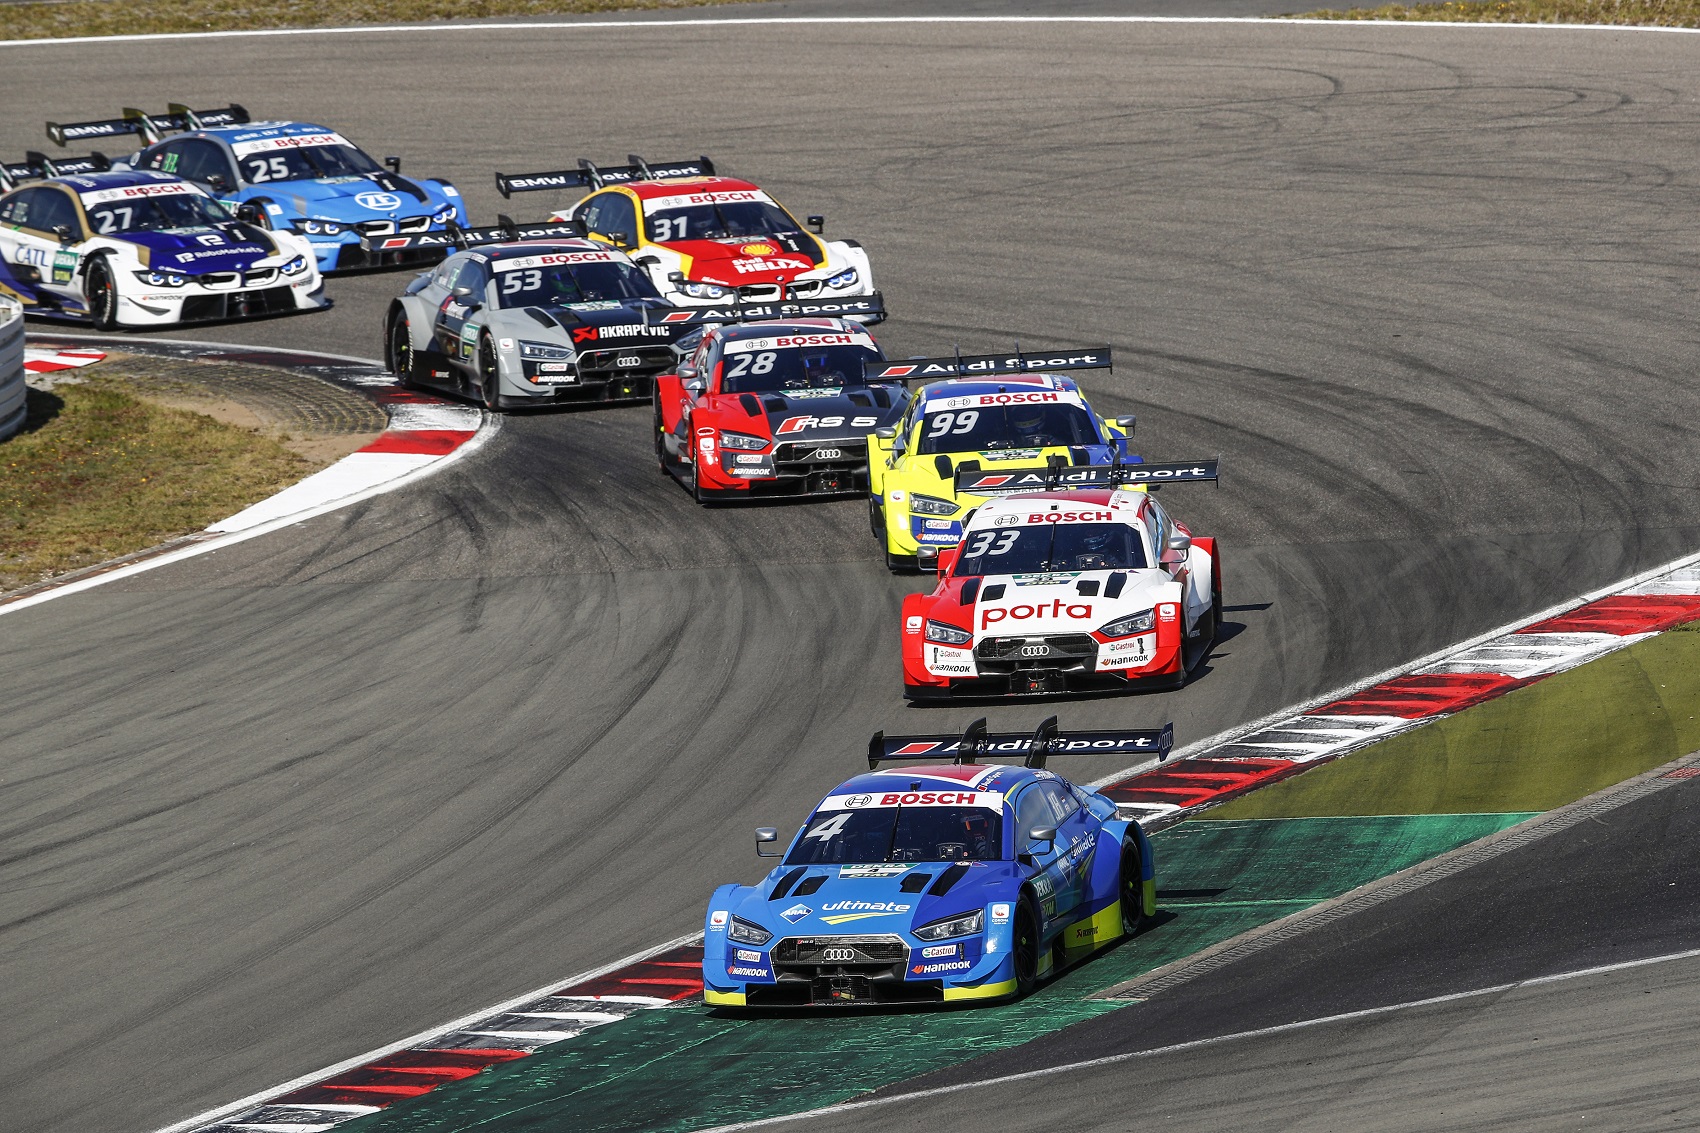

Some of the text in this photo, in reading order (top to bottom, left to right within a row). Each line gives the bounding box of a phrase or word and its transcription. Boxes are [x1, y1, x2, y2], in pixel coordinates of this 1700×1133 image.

[63, 124, 115, 137] BMW
[275, 135, 337, 148] BOSCH
[249, 157, 289, 184] 25
[509, 176, 567, 189] BMW
[124, 184, 186, 197] BOSCH
[690, 192, 755, 204] BOSCH
[95, 207, 133, 235] 27
[654, 216, 688, 242] 31
[541, 253, 611, 265] BOSCH
[735, 260, 811, 274] HELIX
[502, 269, 543, 295] 53
[702, 301, 870, 319] Audi Sport
[777, 335, 852, 347] BOSCH
[726, 352, 777, 379] 28
[1005, 353, 1098, 369] Sport
[979, 393, 1058, 406] BOSCH
[850, 416, 878, 427] 5
[927, 410, 980, 438] 99
[1028, 511, 1112, 524] BOSCH
[964, 530, 1021, 559] 33
[981, 599, 1092, 630] porta
[1115, 642, 1135, 651] Castrol
[880, 793, 976, 806] BOSCH
[804, 812, 854, 842] 4
[821, 900, 911, 913] ultimate
[930, 946, 955, 957] Castrol
